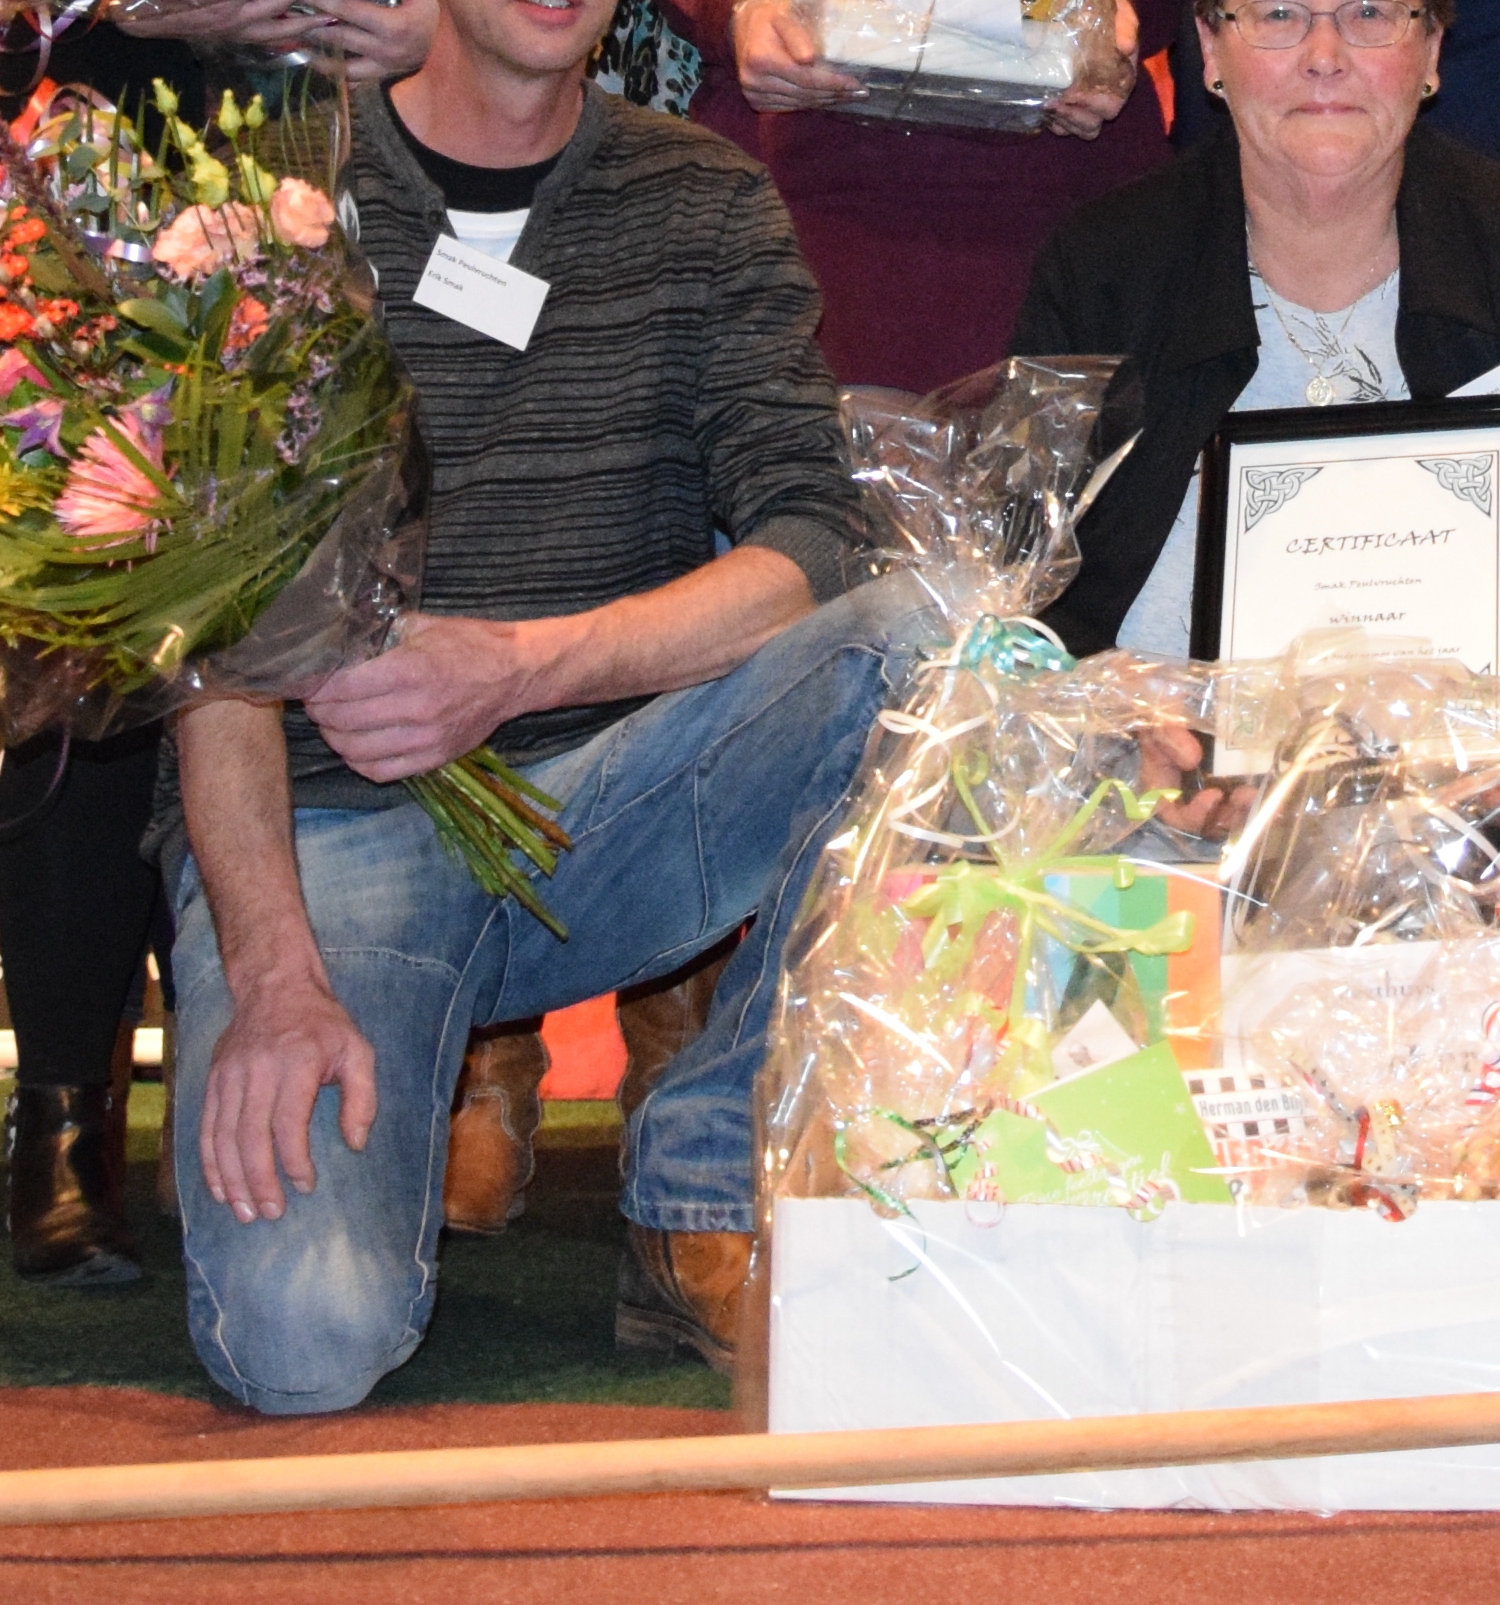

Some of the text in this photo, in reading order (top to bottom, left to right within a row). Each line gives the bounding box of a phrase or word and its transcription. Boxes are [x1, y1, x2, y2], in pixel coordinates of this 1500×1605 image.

[1285, 528, 1457, 556] CERTIFICAAT
[1418, 646, 1434, 655] het
[1436, 646, 1462, 658] jaar
[1199, 1099, 1252, 1118] Herman
[1255, 1095, 1278, 1113] den
